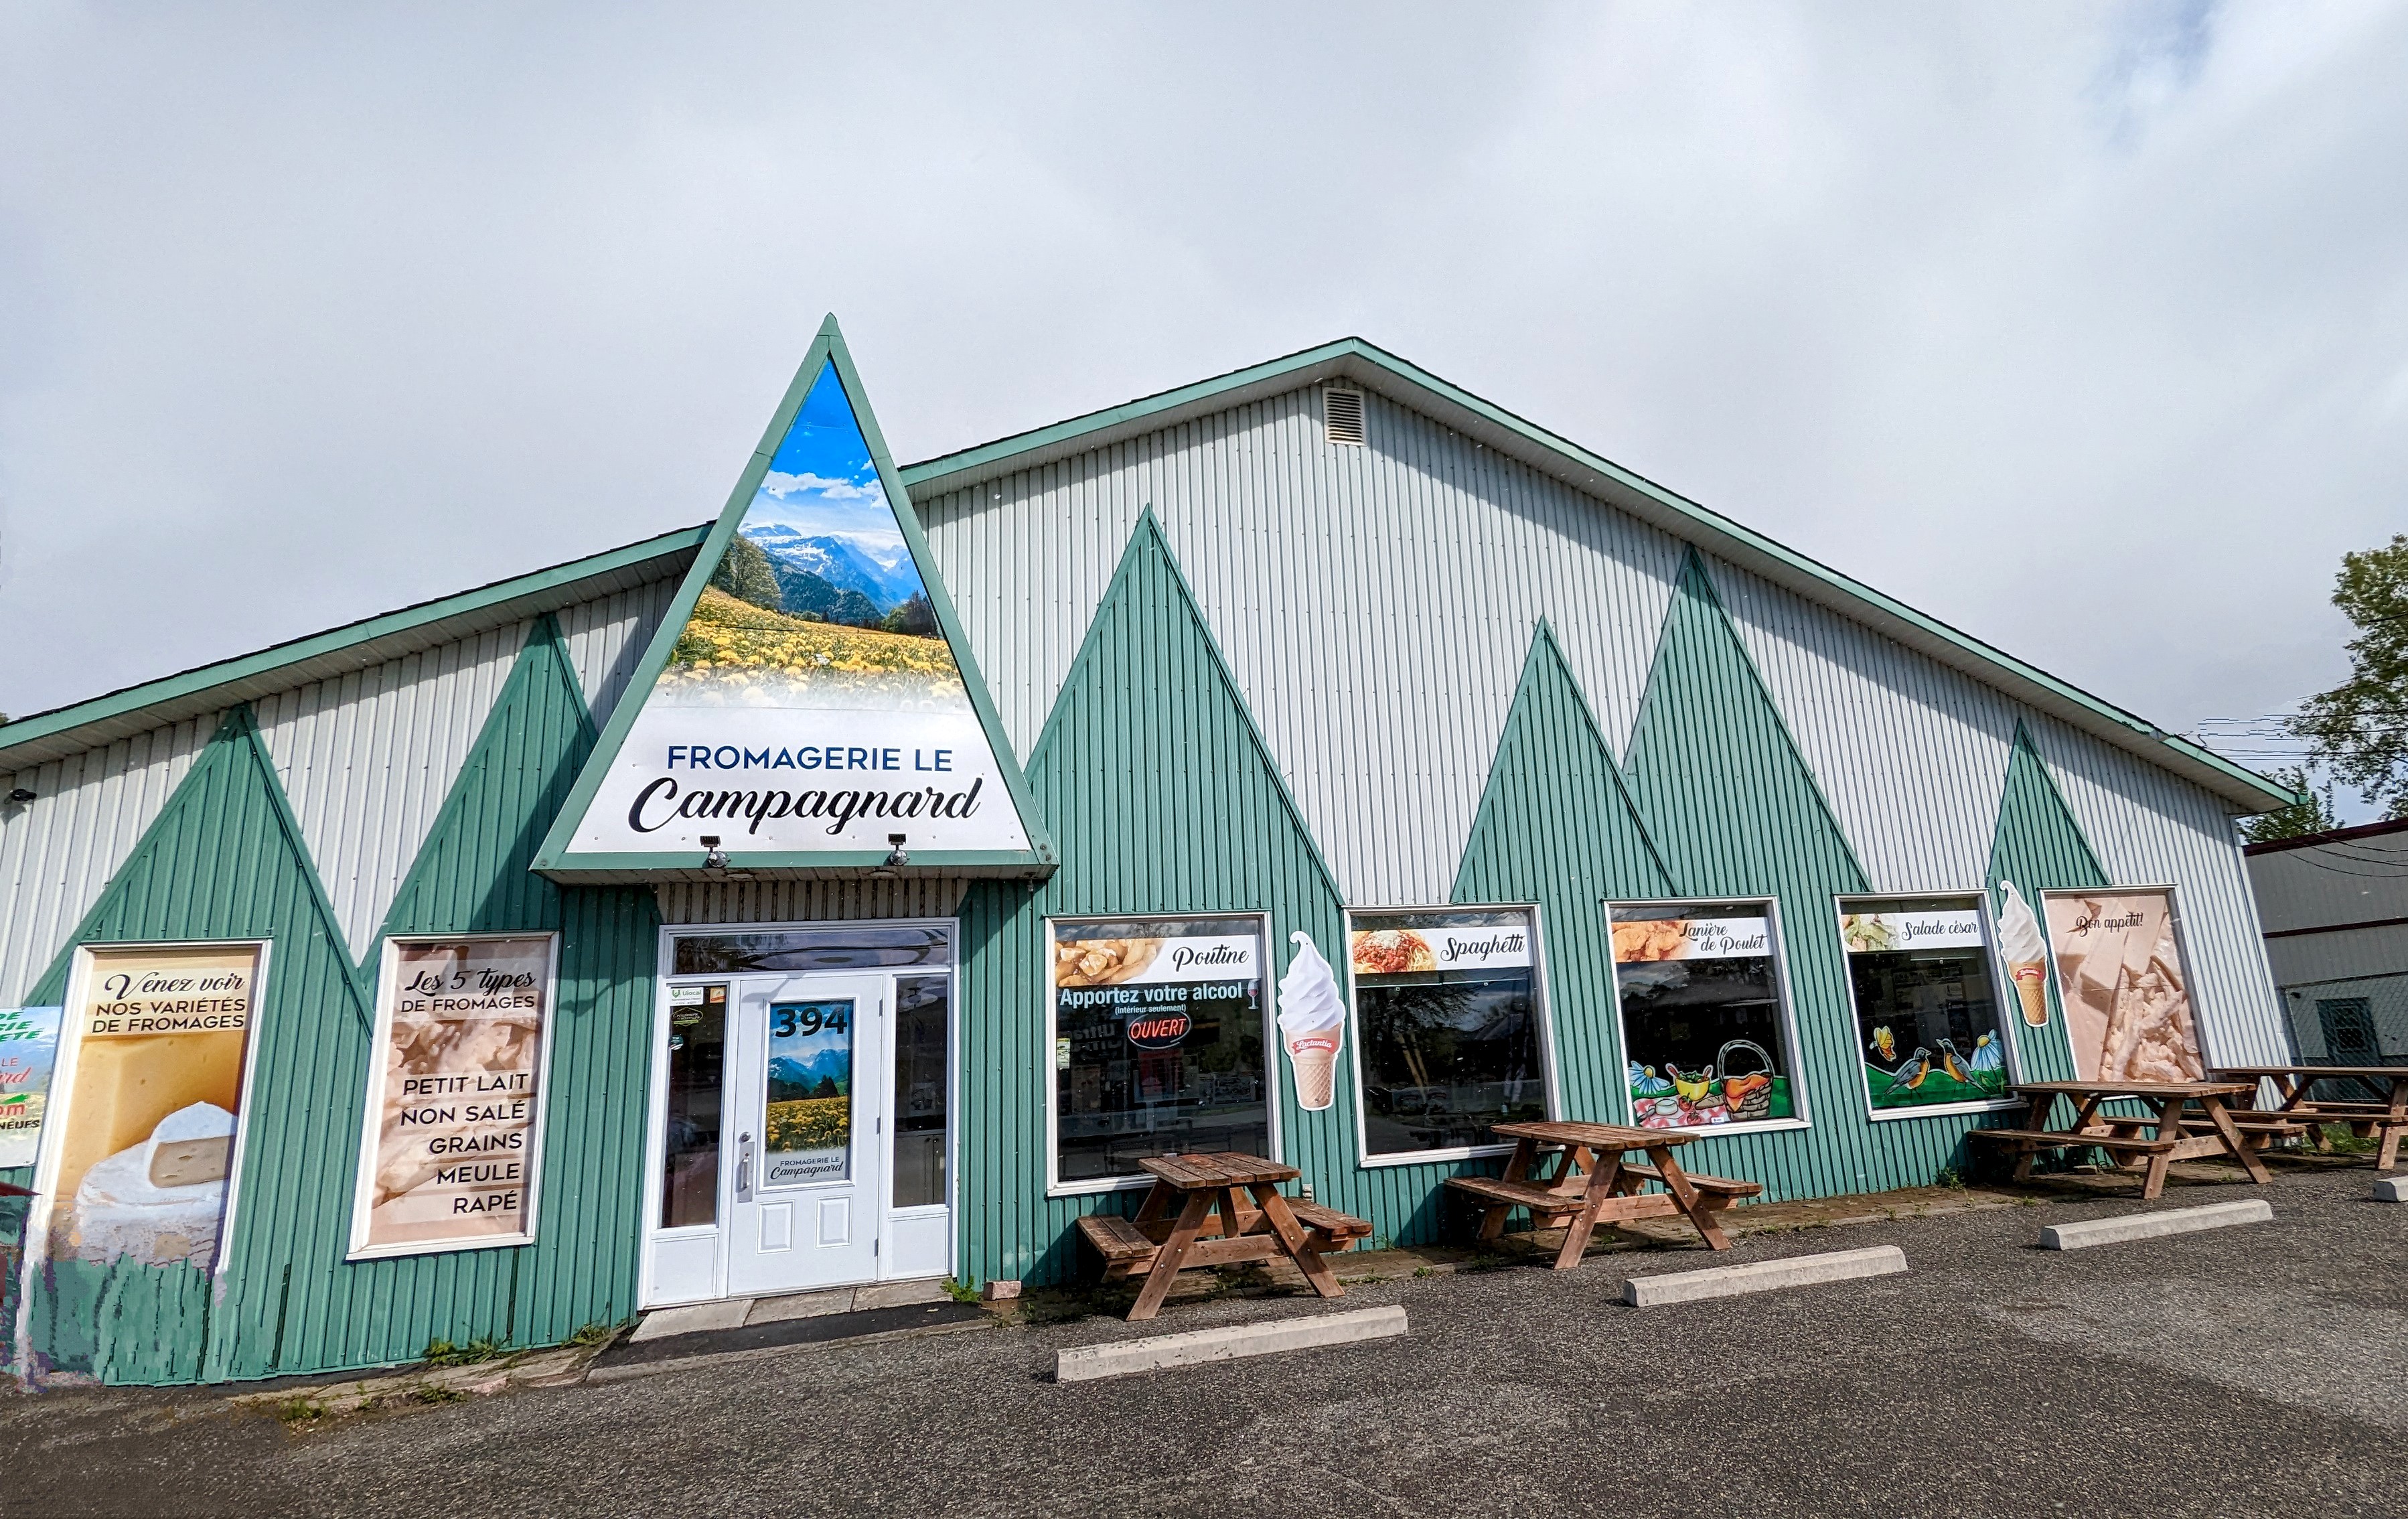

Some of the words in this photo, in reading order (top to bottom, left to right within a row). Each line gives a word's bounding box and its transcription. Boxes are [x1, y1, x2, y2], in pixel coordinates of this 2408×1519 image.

[667, 745, 902, 771] FROMAGERIE
[915, 749, 952, 772] LE
[628, 776, 983, 835] Campagnard
[1679, 922, 1728, 942] Lanière
[1901, 920, 1946, 941] Salade
[1949, 920, 1979, 934] césar
[2076, 916, 2101, 937] Bon
[1440, 934, 1525, 962] Spaghetti
[1700, 936, 1717, 951] de
[1720, 934, 1769, 955] Poulet
[1172, 944, 1250, 972] Poutine
[104, 971, 196, 1001] Venez
[199, 972, 246, 991] voir
[404, 970, 444, 997] Les
[451, 970, 470, 990] 5
[477, 967, 536, 996] types
[401, 999, 425, 1013] DE
[433, 995, 535, 1011] FROMAGES
[1059, 987, 1139, 1009] Apportez
[1144, 985, 1188, 1003] votre
[1192, 982, 1242, 1000] alcool
[96, 1002, 141, 1016] NOS
[150, 997, 246, 1014] VARIÉTÉS
[1148, 1004, 1187, 1013] seulement)
[92, 1019, 121, 1033] DE
[127, 1015, 244, 1031] FROMAGES
[775, 1006, 848, 1039] 394
[1130, 1018, 1187, 1039] OUVERT
[1296, 1039, 1333, 1050] Lactantia
[1, 1058, 18, 1067] LE
[403, 1076, 469, 1096] PETIT
[477, 1074, 529, 1091] LAIT
[401, 1106, 455, 1126] NON
[465, 1100, 526, 1122] SALÉ
[429, 1133, 522, 1155] GRAINS
[770, 1161, 844, 1179] Campagnard
[780, 1157, 829, 1167] FROMAGERIE
[437, 1163, 520, 1185] MEULE
[453, 1190, 518, 1214] RAPÉ
